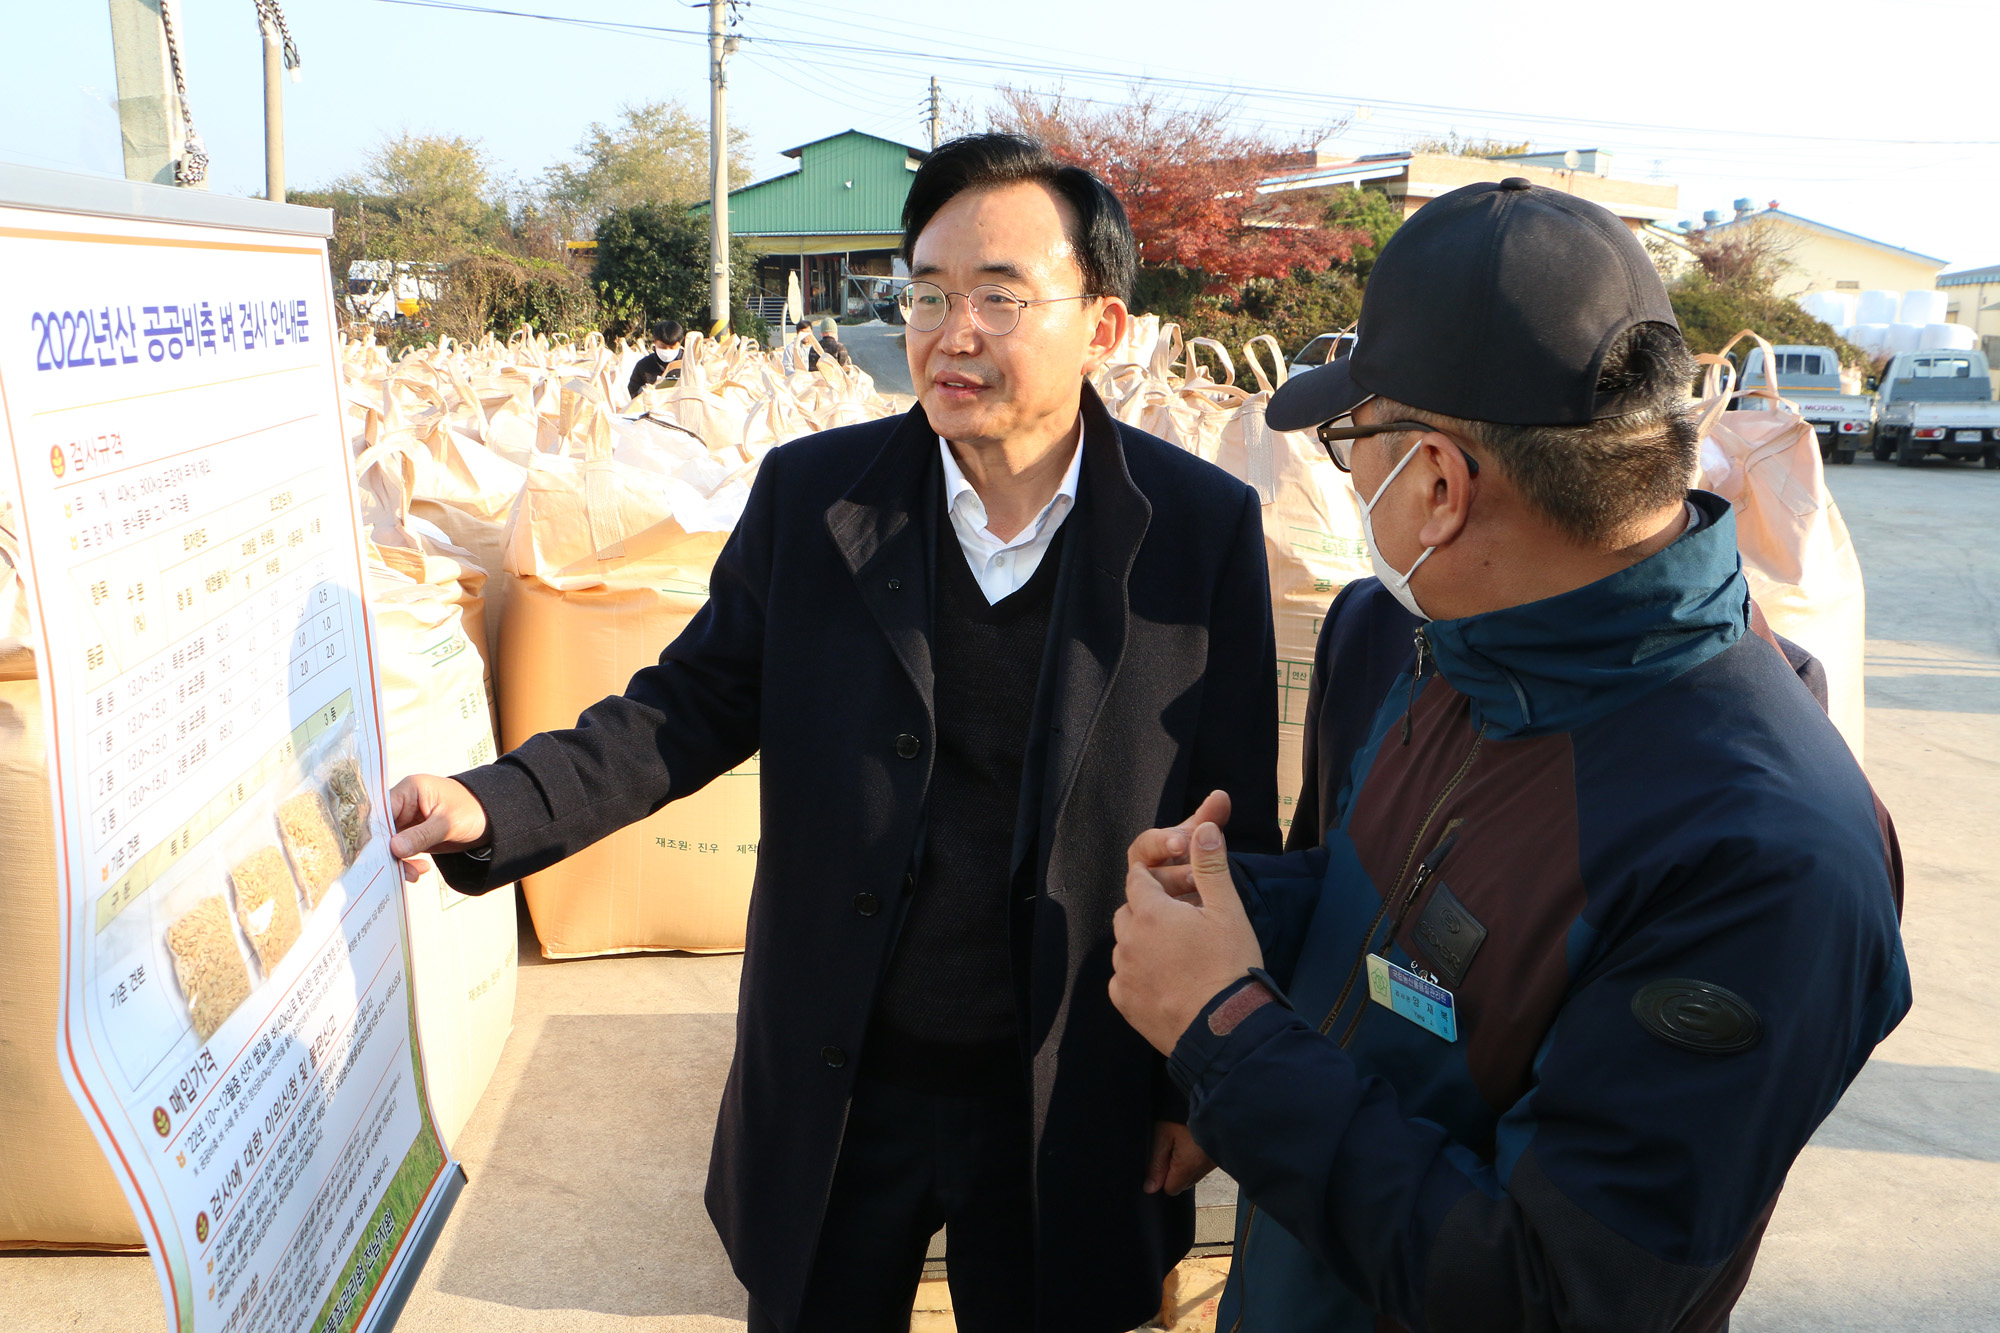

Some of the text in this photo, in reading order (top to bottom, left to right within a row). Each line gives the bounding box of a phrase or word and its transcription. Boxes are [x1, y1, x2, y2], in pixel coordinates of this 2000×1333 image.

[31, 299, 311, 371] 2022년산 공공비축 벼 검사 안내문
[1804, 404, 1845, 412] MOTORS
[69, 430, 125, 473] 검사규격
[318, 588, 328, 604] 0.5
[298, 631, 306, 648] 1.0
[322, 616, 331, 631] 1.0
[300, 660, 309, 677] 2.0
[325, 643, 335, 659] 2.0
[1292, 671, 1307, 681] 연산
[655, 837, 692, 851] 재조원:
[697, 842, 720, 854] 진우
[110, 963, 147, 1010] 기준 견본
[240, 1056, 256, 1083] 산지
[252, 1033, 273, 1066] 쌀값을
[297, 977, 314, 1006] 환산한
[169, 1046, 218, 1115] 매입가격
[209, 1014, 337, 1222] 검사에 대한 이의신청 및 불편신고
[363, 1206, 396, 1271] 전남지원
